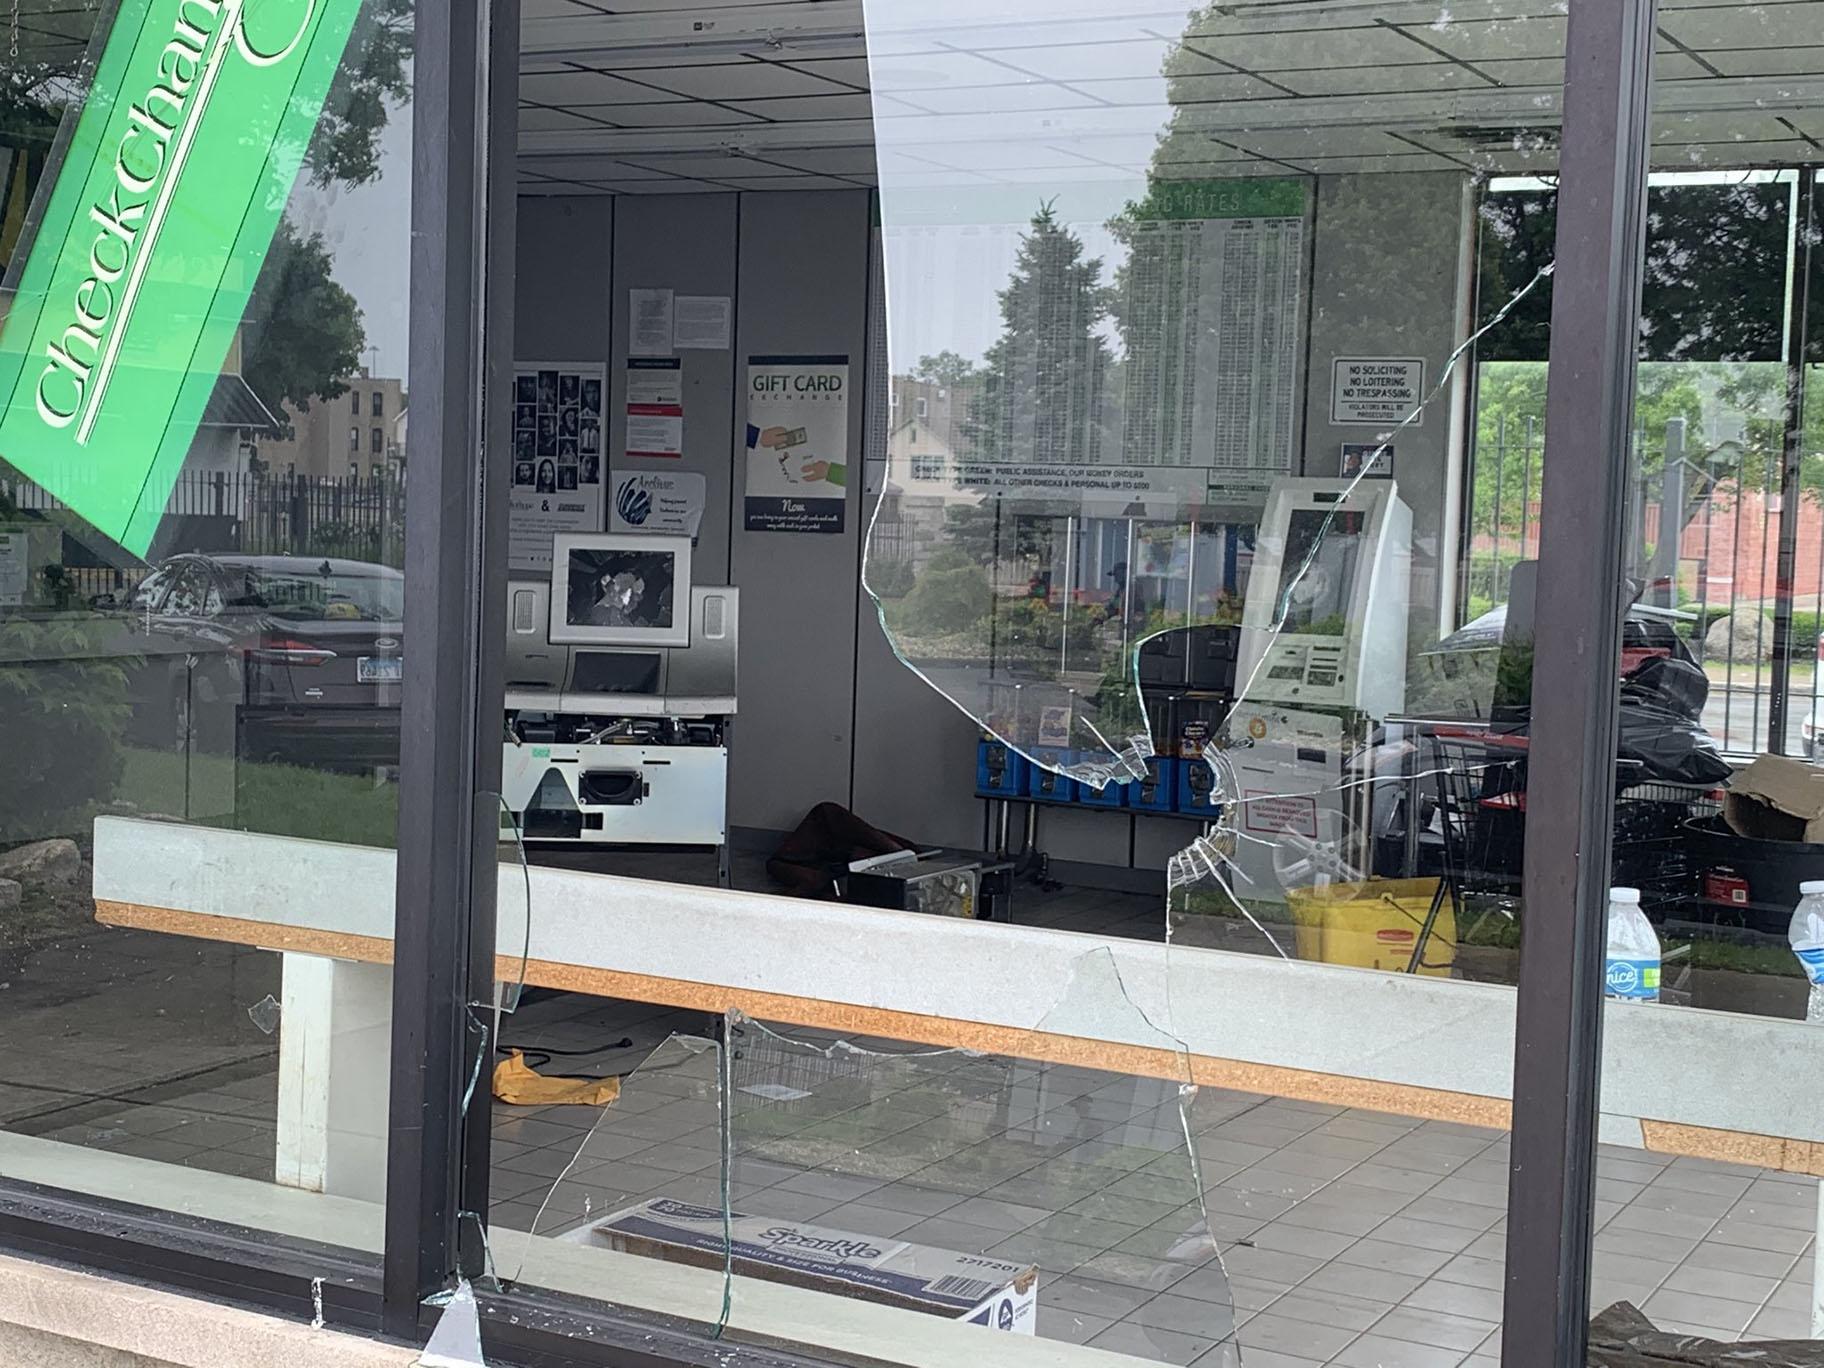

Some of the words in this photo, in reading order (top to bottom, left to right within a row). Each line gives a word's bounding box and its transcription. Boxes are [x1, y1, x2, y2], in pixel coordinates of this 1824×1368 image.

[1350, 366, 1360, 375] NO
[1362, 366, 1407, 375] SOLICITING
[753, 375, 790, 391] GIFT
[794, 375, 842, 391] CARD
[1350, 378, 1360, 386] NO
[1363, 378, 1405, 386] LOITERING
[1343, 389, 1354, 397] NO
[1357, 389, 1411, 398] TRESPASSING
[757, 1226, 882, 1258] Sparkle
[955, 1256, 1020, 1272] 2717201
